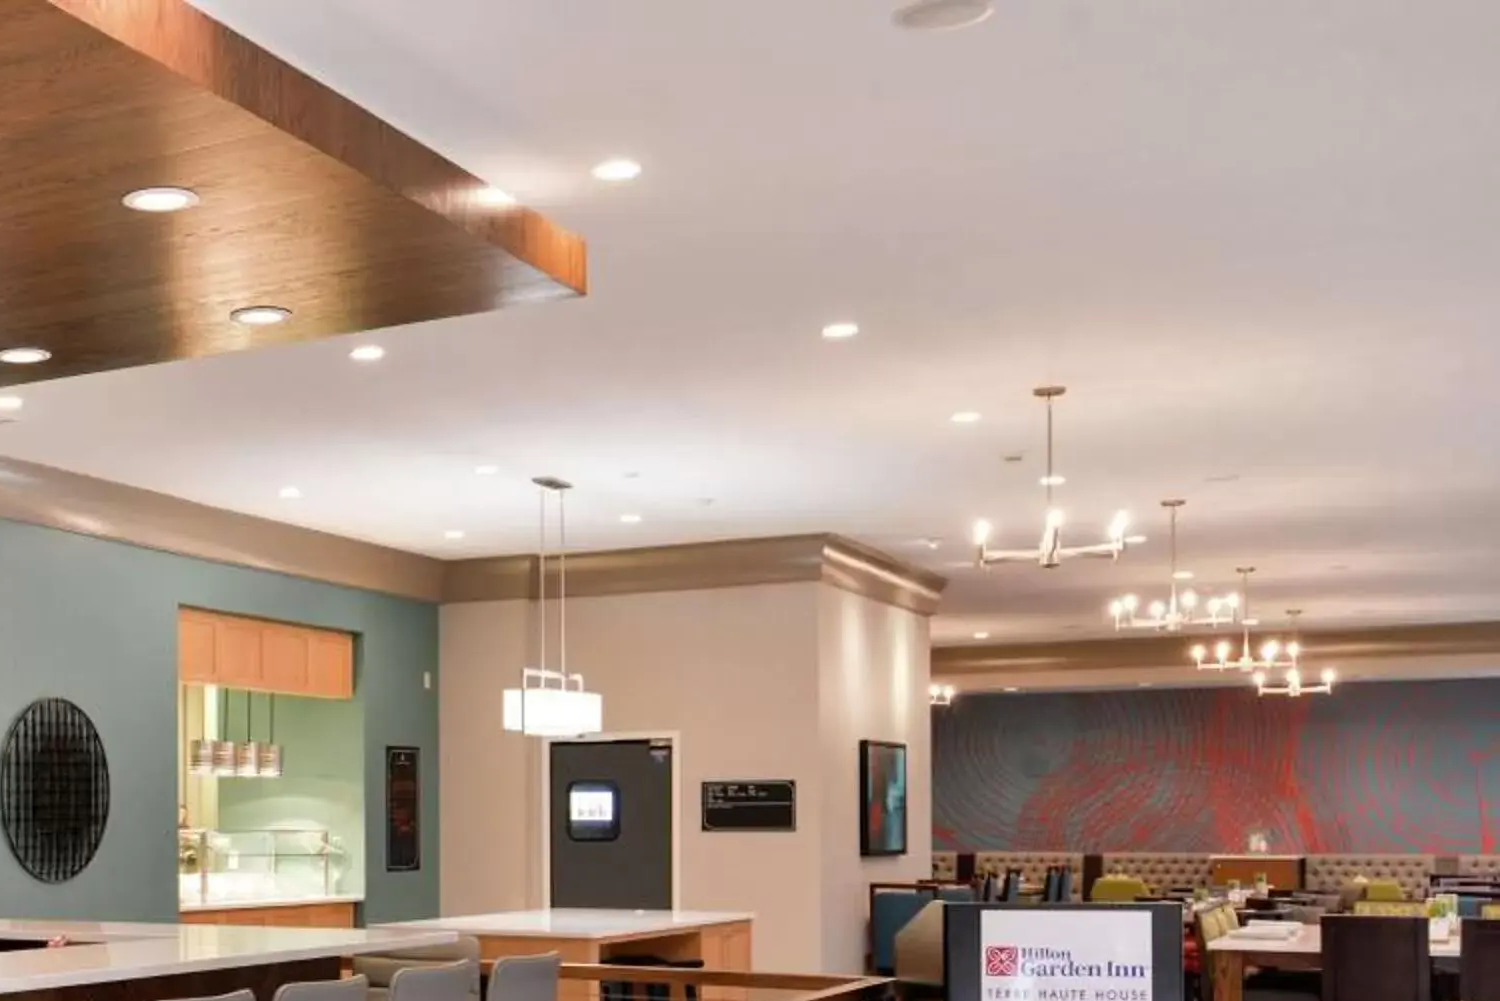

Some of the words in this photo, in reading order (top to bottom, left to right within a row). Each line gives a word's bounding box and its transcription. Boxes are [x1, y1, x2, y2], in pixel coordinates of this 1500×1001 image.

[1021, 948, 1071, 961] Hilton
[1021, 961, 1102, 977] Garden
[1107, 961, 1145, 977] Inn
[1038, 989, 1087, 1001] HAUTE
[1095, 989, 1148, 1001] HOUSE
